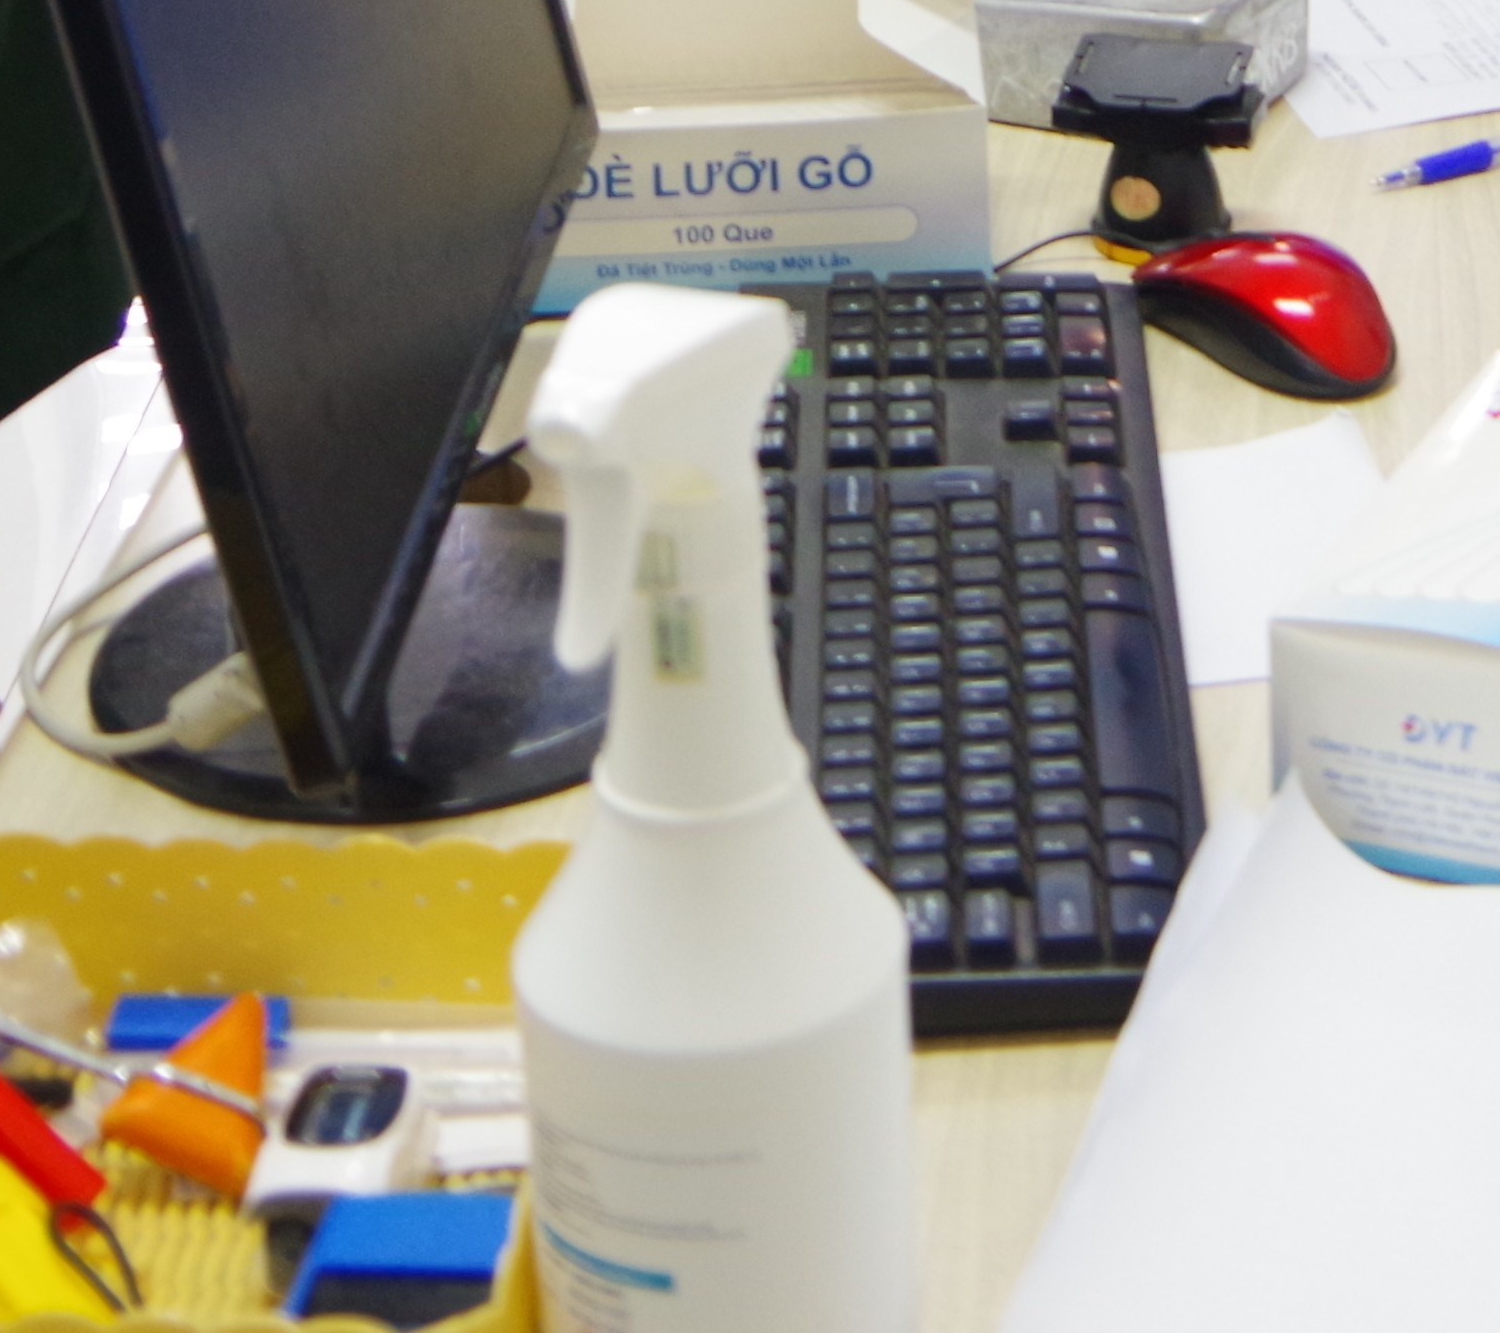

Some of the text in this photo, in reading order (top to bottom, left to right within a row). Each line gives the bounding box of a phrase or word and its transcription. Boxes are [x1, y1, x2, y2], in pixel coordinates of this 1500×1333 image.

[653, 150, 781, 197] LƯỠI
[797, 144, 874, 191] GỖ
[672, 222, 775, 245] 100 Que
